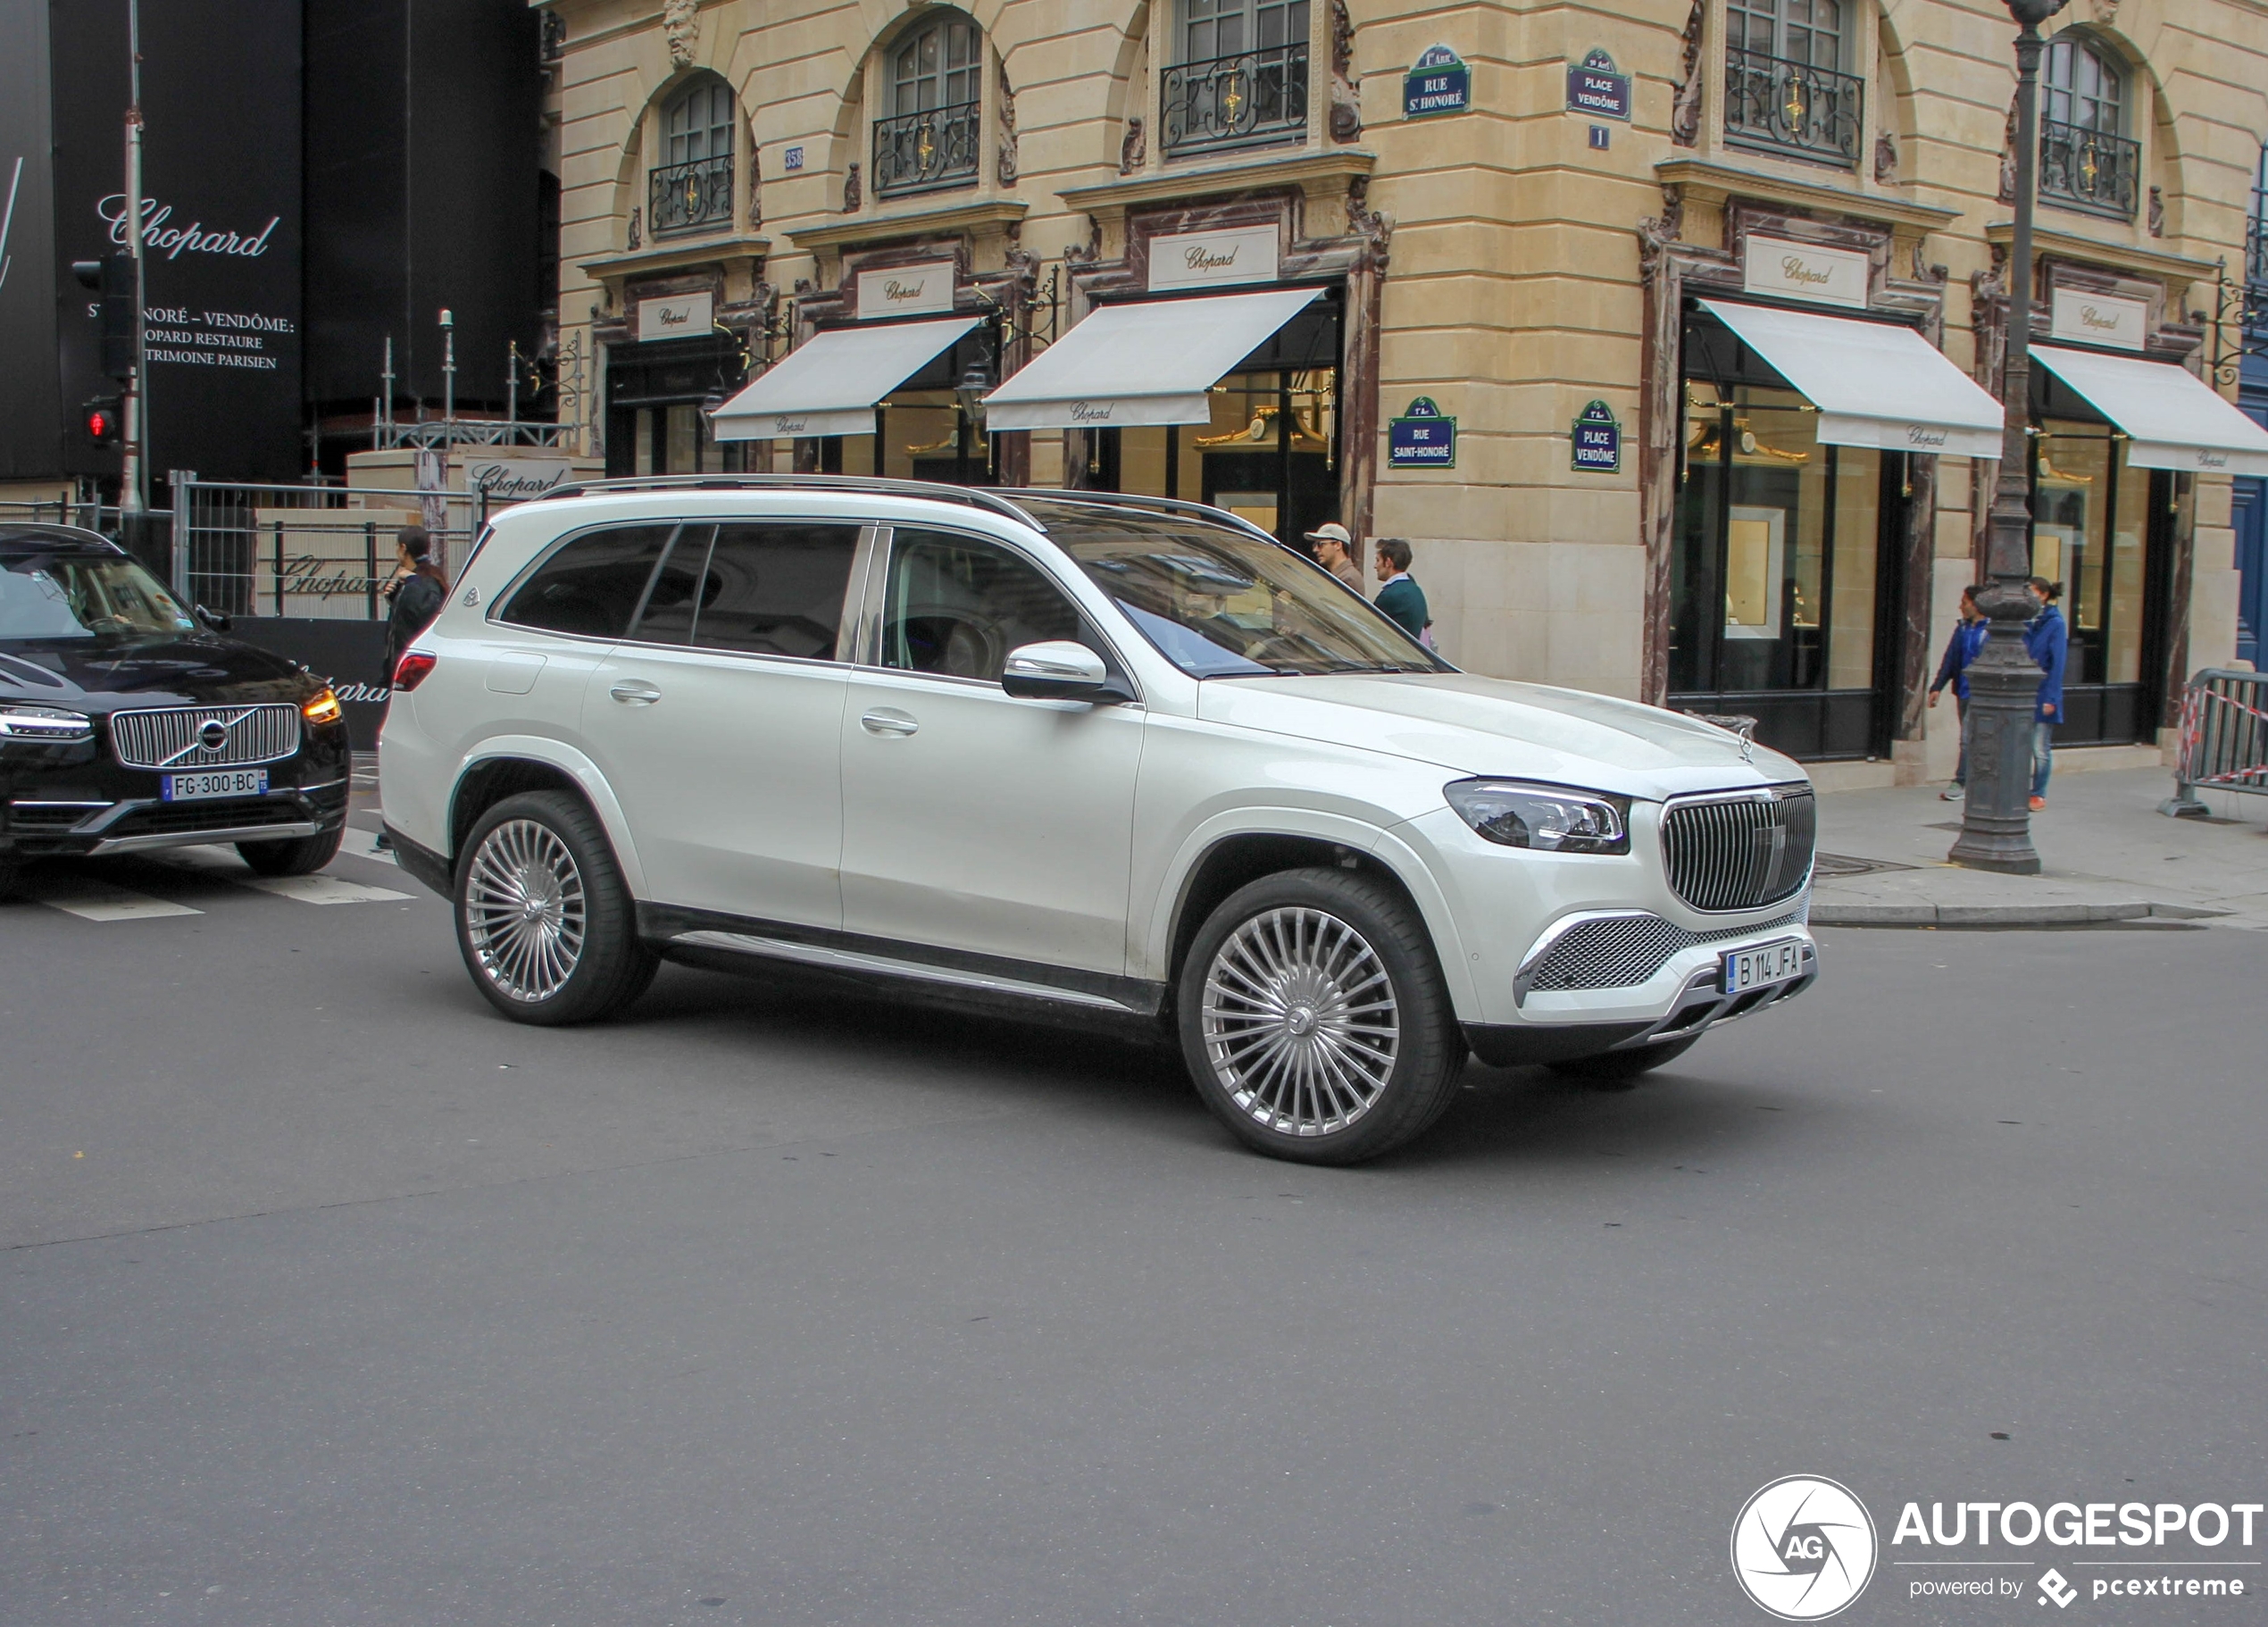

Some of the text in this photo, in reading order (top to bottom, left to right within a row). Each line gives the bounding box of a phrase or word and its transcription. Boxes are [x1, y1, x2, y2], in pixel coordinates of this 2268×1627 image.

[1424, 77, 1448, 93] RUE
[1585, 77, 1613, 92] PLACE
[1578, 92, 1620, 111] VENDÔME
[1597, 129, 1603, 146] 1
[786, 149, 803, 168] 358
[97, 194, 280, 260] Chopard
[1184, 245, 1239, 273] Chopard
[1781, 255, 1834, 286] Chopard
[884, 280, 925, 304] Chopard
[196, 331, 263, 349] RESTAURE
[218, 354, 277, 369] PARISIEN
[1070, 400, 1115, 424] Chopard
[1413, 429, 1430, 440] RUE
[1583, 430, 1610, 445] PLACE
[1907, 424, 1948, 449] Chopard
[1394, 444, 1449, 458] SAINT-HONORÉ
[1577, 447, 1615, 463] VENDÔME
[175, 773, 255, 796] FG-300-BC
[1740, 945, 1797, 986] B 114 JFA
